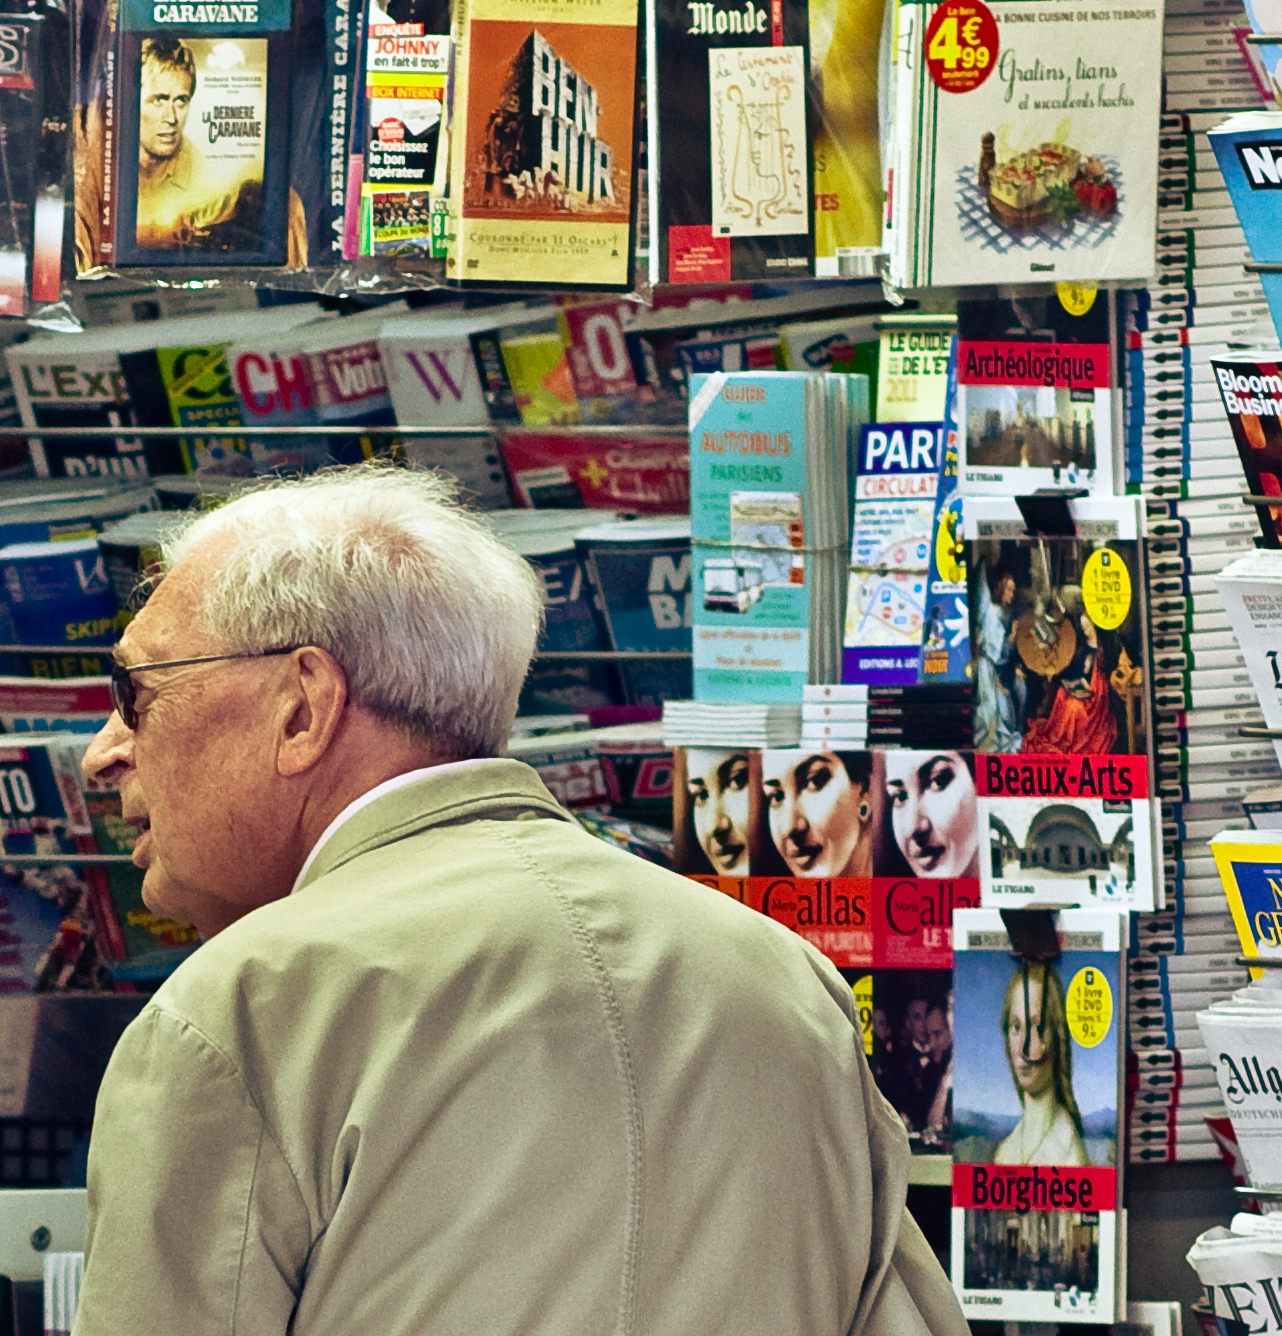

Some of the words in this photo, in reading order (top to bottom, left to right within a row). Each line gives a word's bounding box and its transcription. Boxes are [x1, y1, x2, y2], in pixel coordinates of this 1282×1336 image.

[153, 4, 259, 23] CARAVANE
[687, 1, 768, 35] Monde
[1038, 11, 1074, 22] CUISINE
[1091, 11, 1111, 21] NOS
[1113, 9, 1156, 20] TERROIRS
[375, 39, 440, 54] JOHNNY
[374, 57, 390, 67] en
[372, 88, 394, 98] BOX
[397, 87, 441, 99] INTERNET
[370, 140, 429, 153] Choisissez
[383, 153, 405, 165] bon
[369, 166, 425, 180] opérateur
[965, 350, 1095, 386] Archéologique
[722, 385, 765, 402] GUIDE
[701, 431, 792, 455] AUTOBUS
[710, 463, 783, 483] PARISIENS
[1100, 568, 1121, 579] livre
[1101, 581, 1121, 592] DVD
[986, 757, 1134, 798] Beaux-Arts
[972, 1166, 1093, 1215] Borghèse
[977, 1296, 1003, 1305] FIGARO
